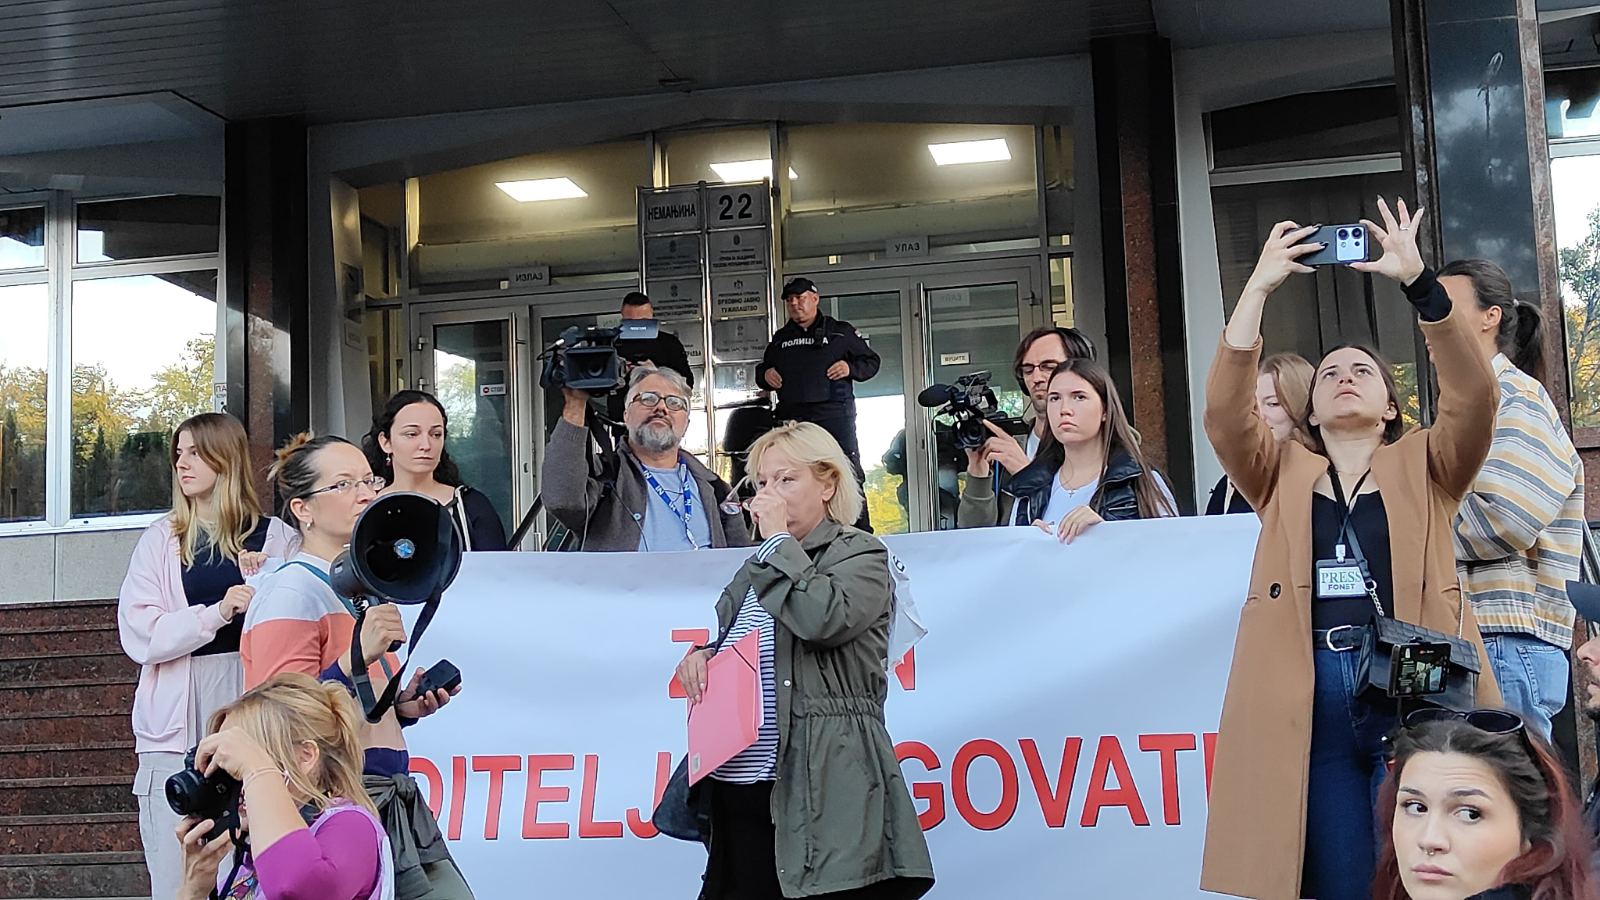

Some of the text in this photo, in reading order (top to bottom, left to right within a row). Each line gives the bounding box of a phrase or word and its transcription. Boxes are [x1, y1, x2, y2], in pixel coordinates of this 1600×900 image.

[647, 193, 753, 221] НЕМАЊИНА 22
[895, 242, 920, 252] УЛАЗ
[515, 272, 543, 282] ИЗЛАЗ
[781, 336, 829, 349] ПОЛИЦА
[1321, 571, 1361, 583] PRESS
[409, 732, 1219, 841] DITELJ GOVAT
